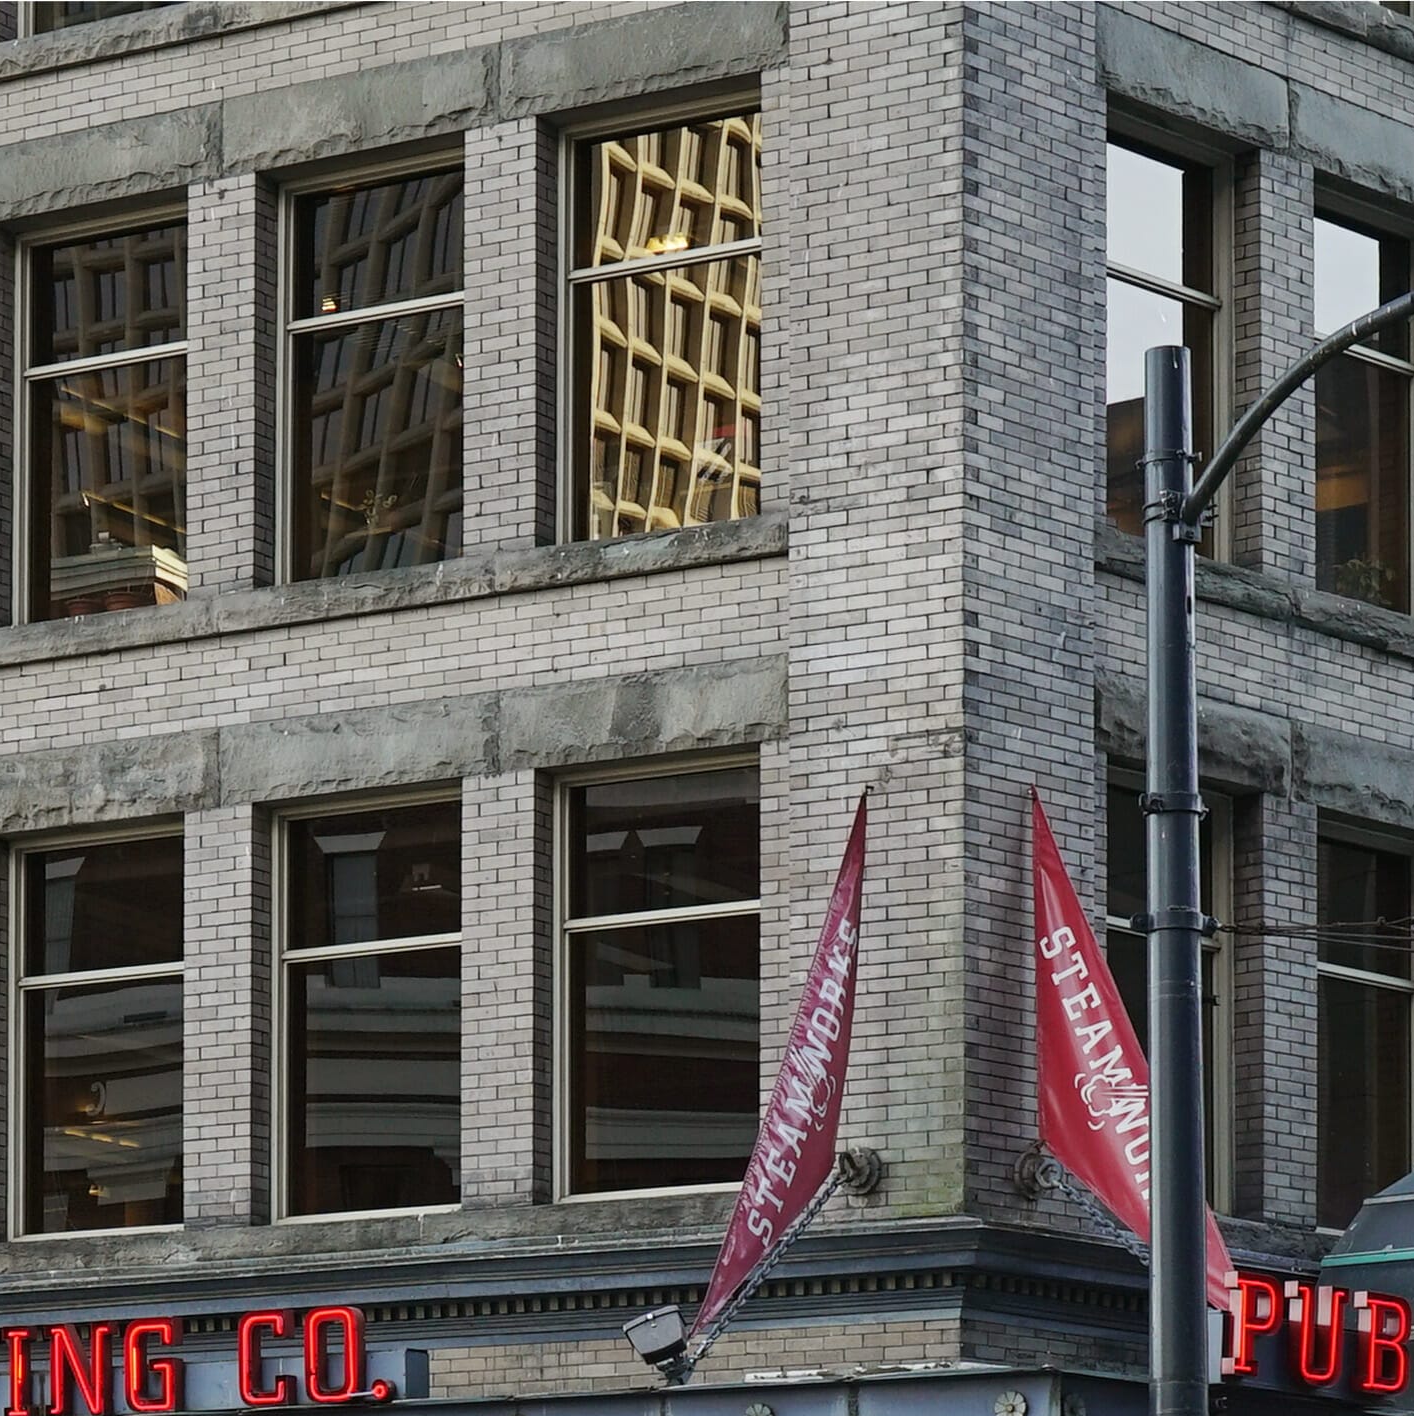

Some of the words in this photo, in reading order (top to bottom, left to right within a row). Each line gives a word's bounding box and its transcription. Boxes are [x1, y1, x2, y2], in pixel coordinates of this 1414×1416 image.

[1040, 925, 1149, 1211] STEAMWO
[238, 1305, 396, 1406] CO.
[1227, 1271, 1412, 1396] PUB
